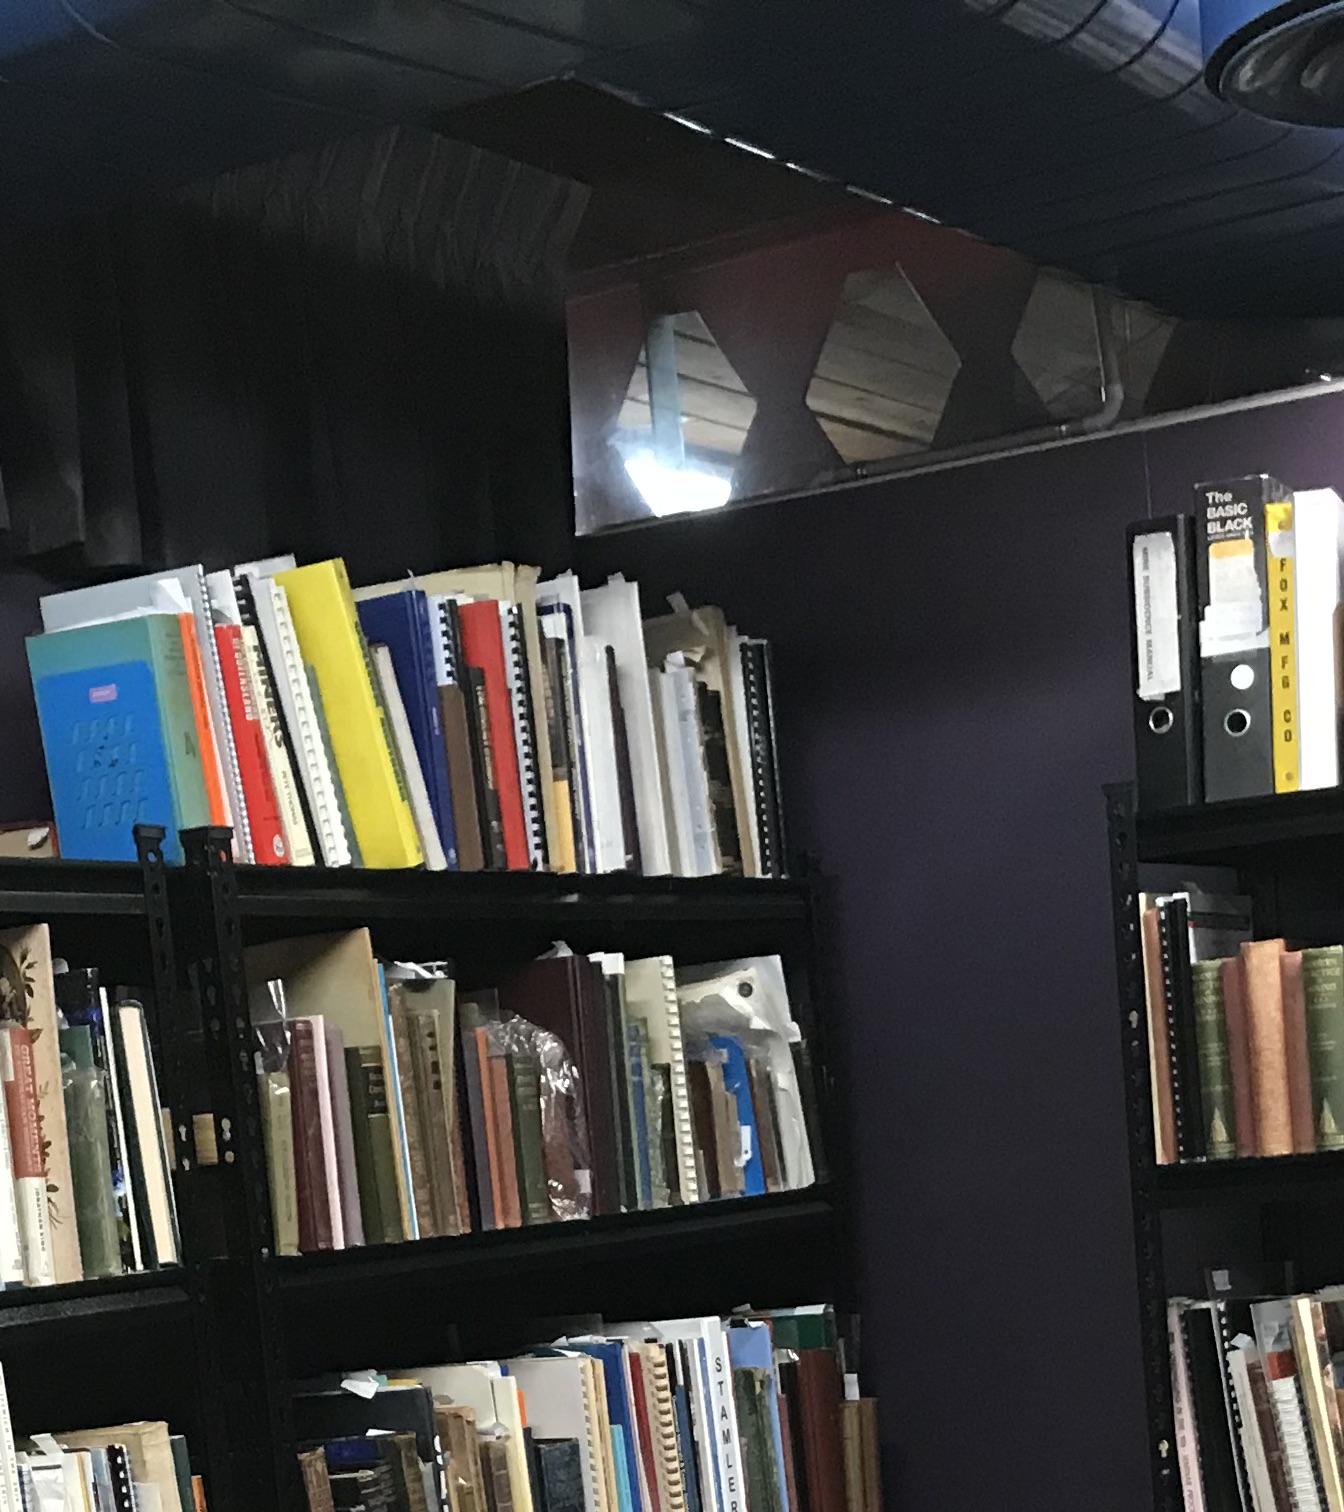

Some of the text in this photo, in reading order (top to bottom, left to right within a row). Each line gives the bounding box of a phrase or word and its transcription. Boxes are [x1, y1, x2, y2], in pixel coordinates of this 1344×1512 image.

[1205, 491, 1233, 504] The
[1206, 502, 1248, 519] BASIC
[1206, 516, 1253, 534] BLACK
[1279, 559, 1289, 612] FOX
[1278, 632, 1291, 689] MFG
[20, 1044, 42, 1174] GREAT MOMENTS
[34, 1188, 43, 1229] JONATHAN
[0, 1393, 11, 1433] IPSWICH
